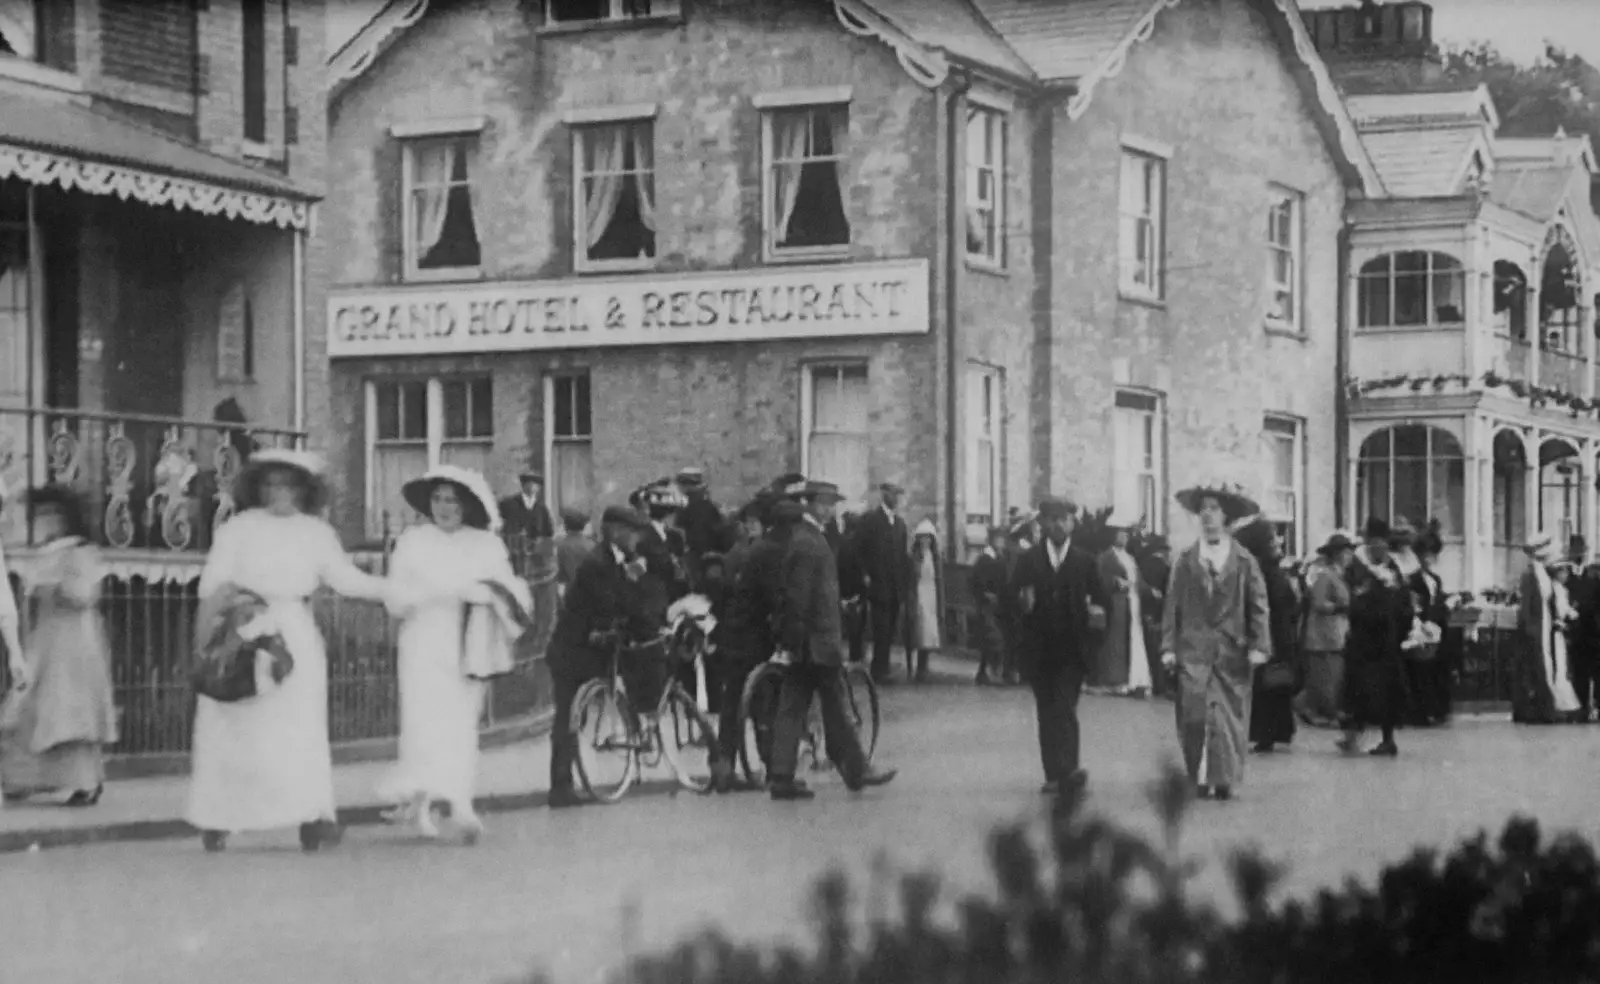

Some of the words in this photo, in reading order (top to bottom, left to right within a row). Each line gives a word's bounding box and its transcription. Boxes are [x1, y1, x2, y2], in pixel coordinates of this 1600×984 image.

[335, 302, 456, 341] GRAND
[468, 297, 589, 335] HOTEL
[604, 296, 626, 329] &
[642, 280, 907, 327] RESTAURANT
